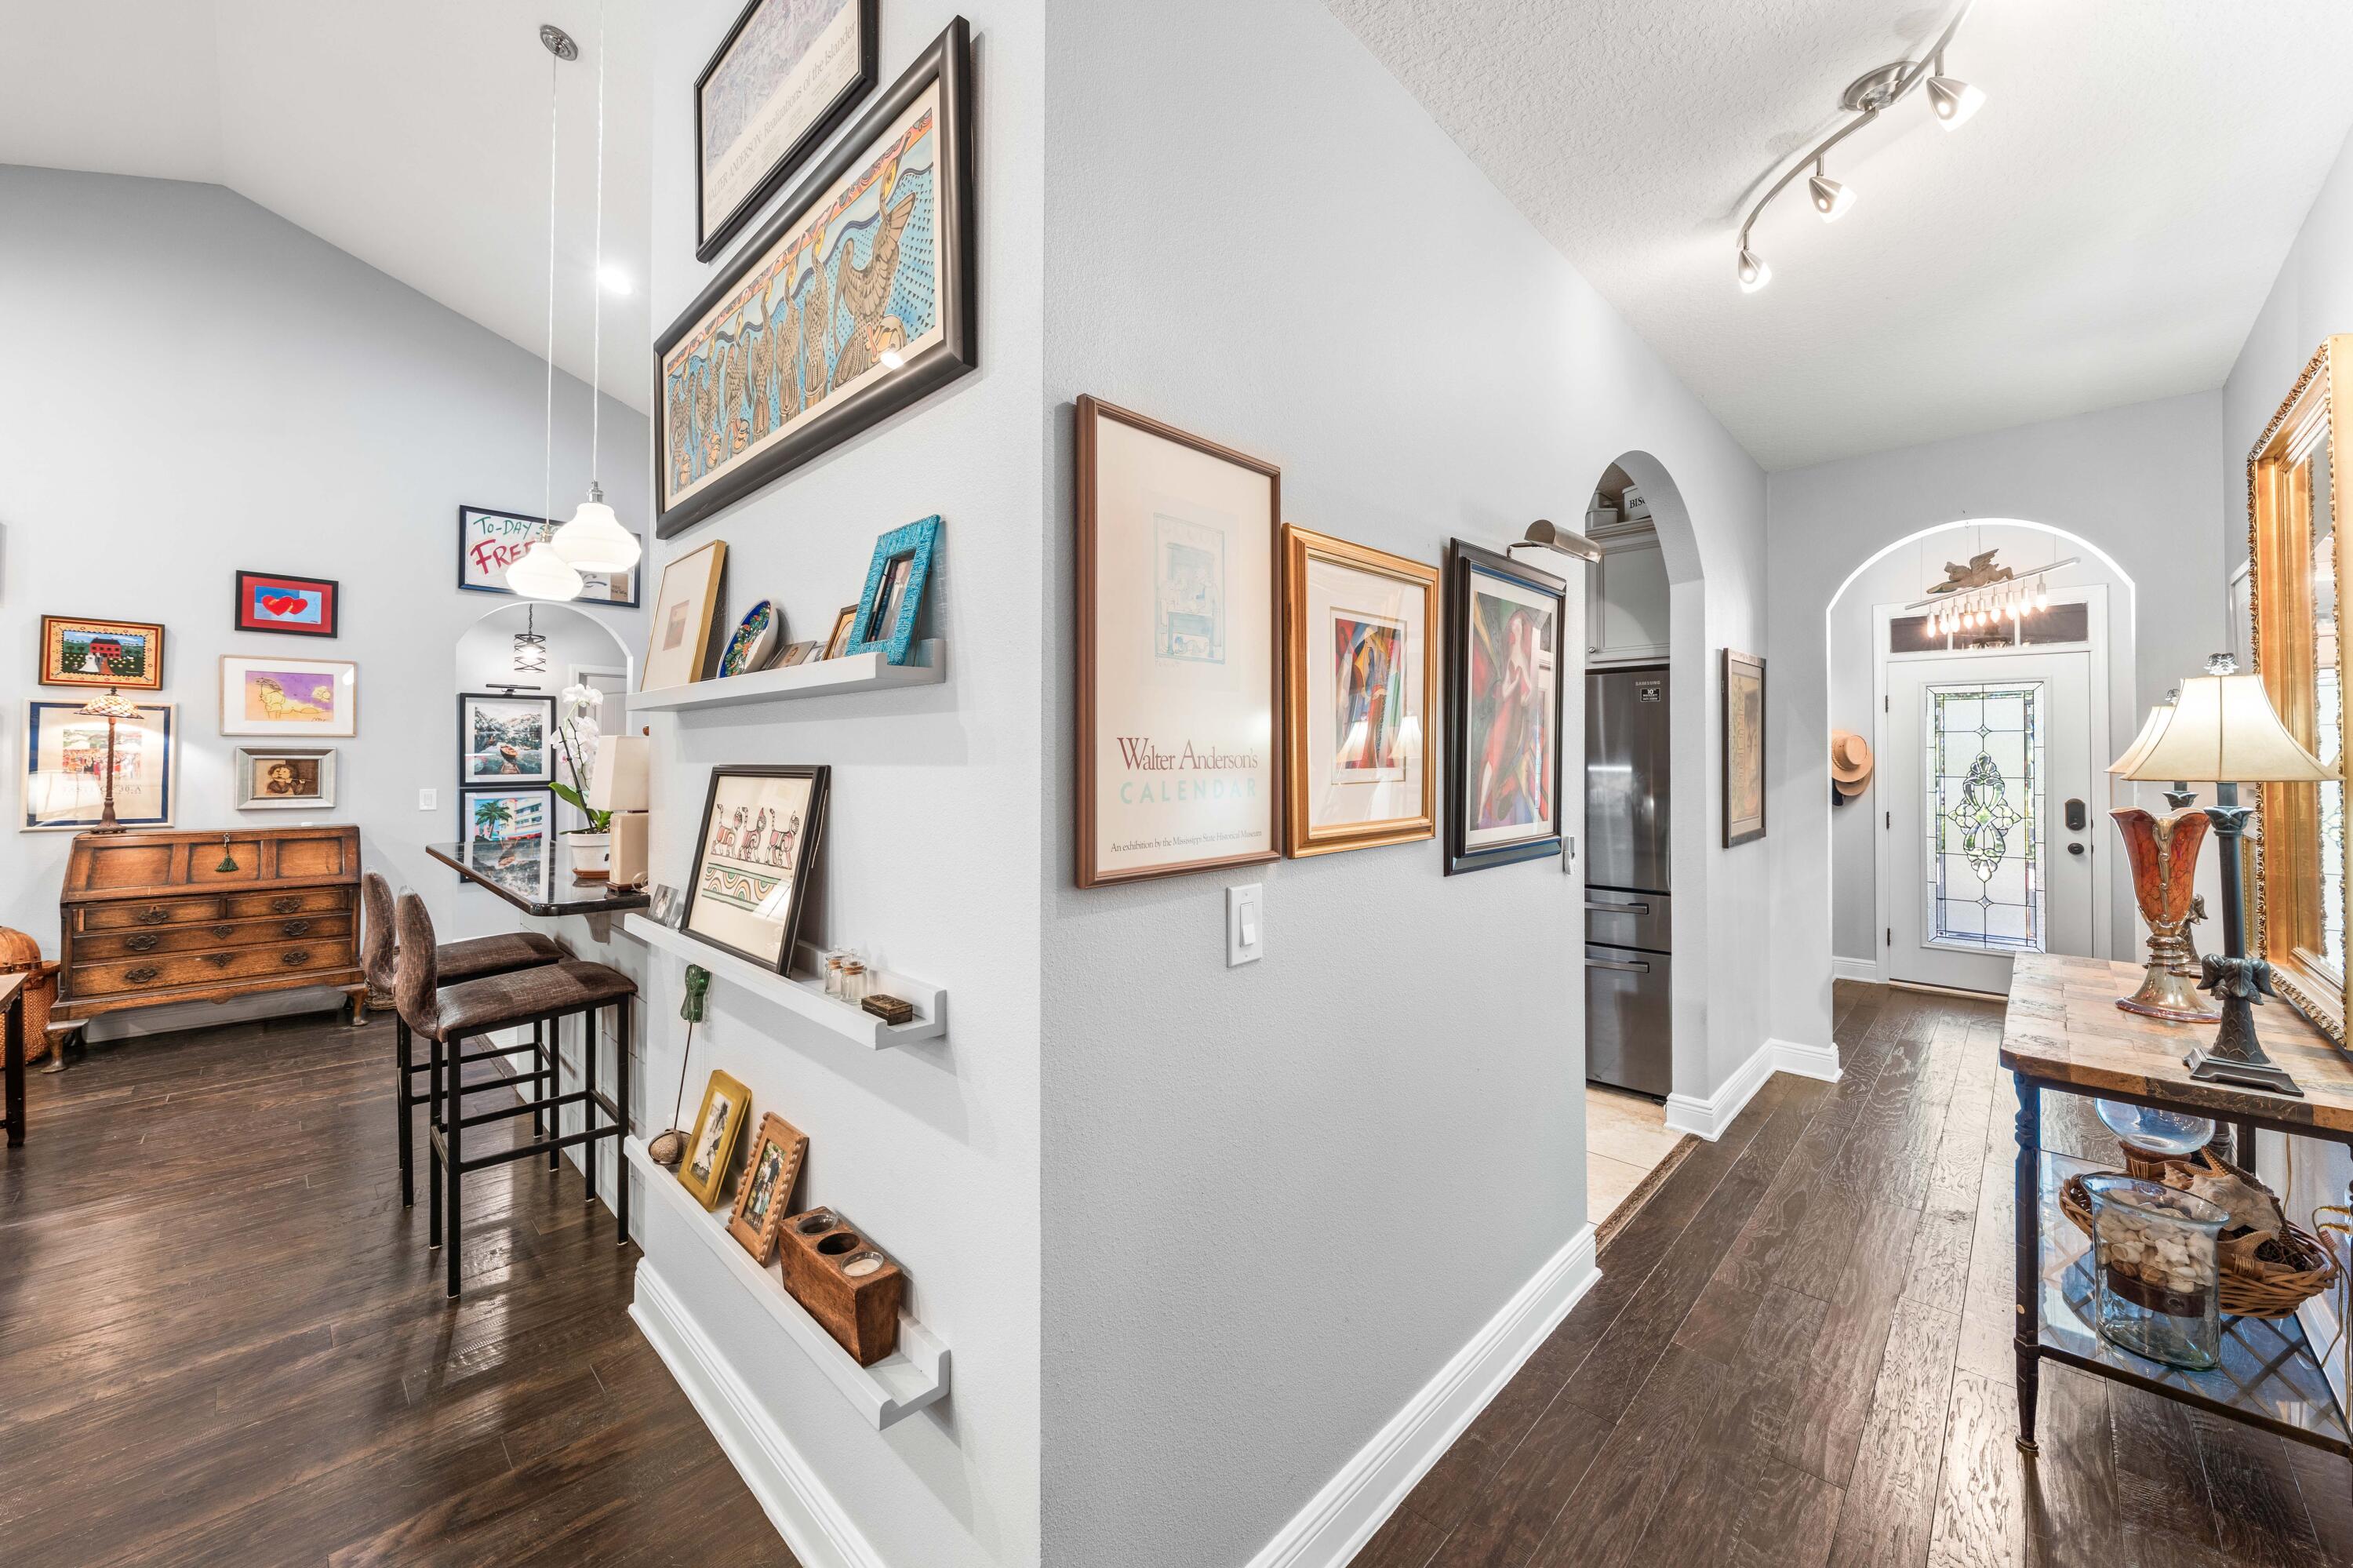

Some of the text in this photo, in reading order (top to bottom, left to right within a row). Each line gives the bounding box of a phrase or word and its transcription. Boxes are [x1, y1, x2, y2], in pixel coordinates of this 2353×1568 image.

[764, 85, 802, 138] Realizations
[803, 72, 811, 92] of
[813, 60, 824, 79] the
[825, 20, 856, 65] Islander
[1117, 737, 1258, 770] Walter Anderson's
[1120, 777, 1256, 804] CALENDAR
[1111, 829, 1262, 853] An exhibition by the Mississippi State Historical Museum
